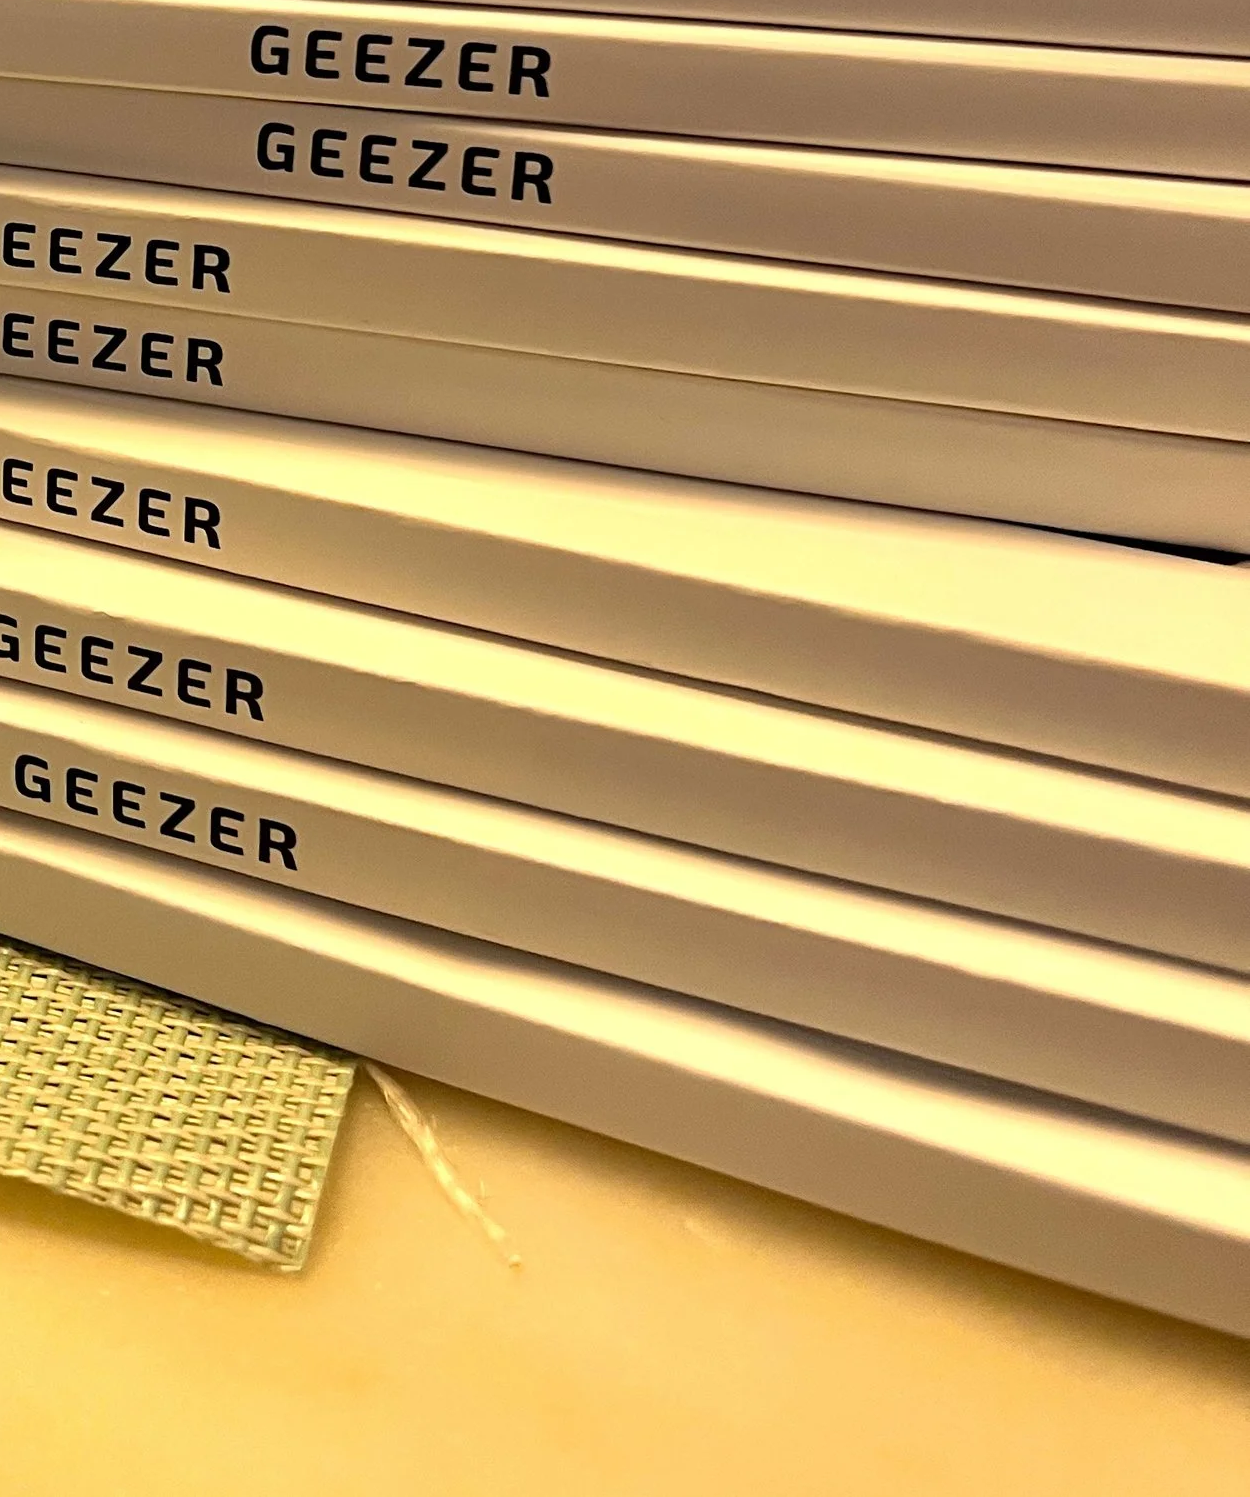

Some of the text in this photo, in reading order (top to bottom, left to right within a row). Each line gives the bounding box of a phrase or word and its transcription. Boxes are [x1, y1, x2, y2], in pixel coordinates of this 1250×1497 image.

[250, 25, 551, 98] GEEZER
[256, 122, 554, 205] GEEZER
[14, 754, 298, 872] GEEZER
